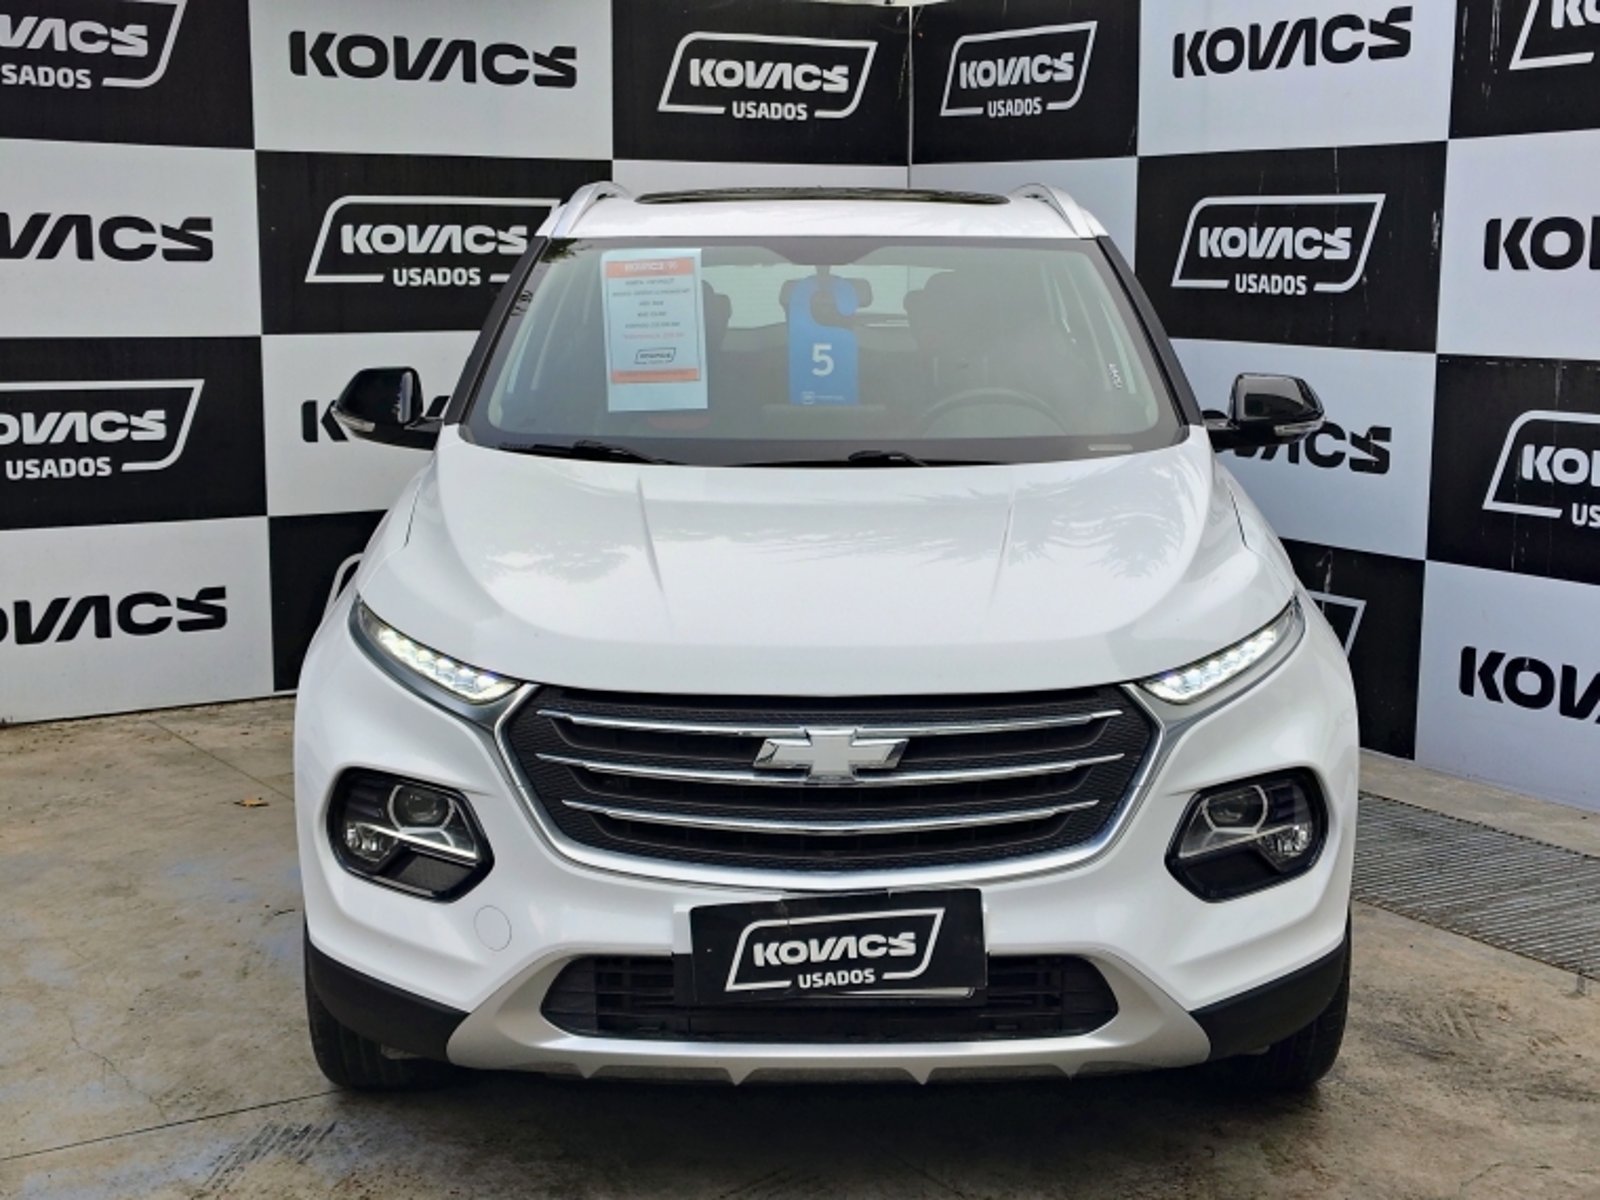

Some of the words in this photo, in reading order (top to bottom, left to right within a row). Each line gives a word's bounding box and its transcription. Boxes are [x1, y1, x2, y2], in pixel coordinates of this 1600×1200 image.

[1173, 6, 1413, 78] KOVACS
[289, 31, 577, 89] KOVACS
[689, 59, 850, 92] KOVACS
[959, 52, 1074, 88] KOVACS
[1, 64, 92, 90] SADOS
[732, 101, 808, 121] USADOS
[987, 97, 1042, 118] USADOS
[341, 224, 528, 255] KOVACS
[1199, 227, 1352, 260] KOVACS
[1484, 216, 1600, 270] KO
[392, 268, 481, 287] USADOS
[1235, 273, 1307, 295] USADOS
[812, 343, 834, 376] 5
[5, 456, 112, 480] USADOS
[1522, 444, 1600, 486] KO
[0, 586, 227, 645] VACS
[1459, 645, 1600, 725] KOV
[753, 932, 916, 967] KOVACS
[799, 968, 876, 989] USADOS
